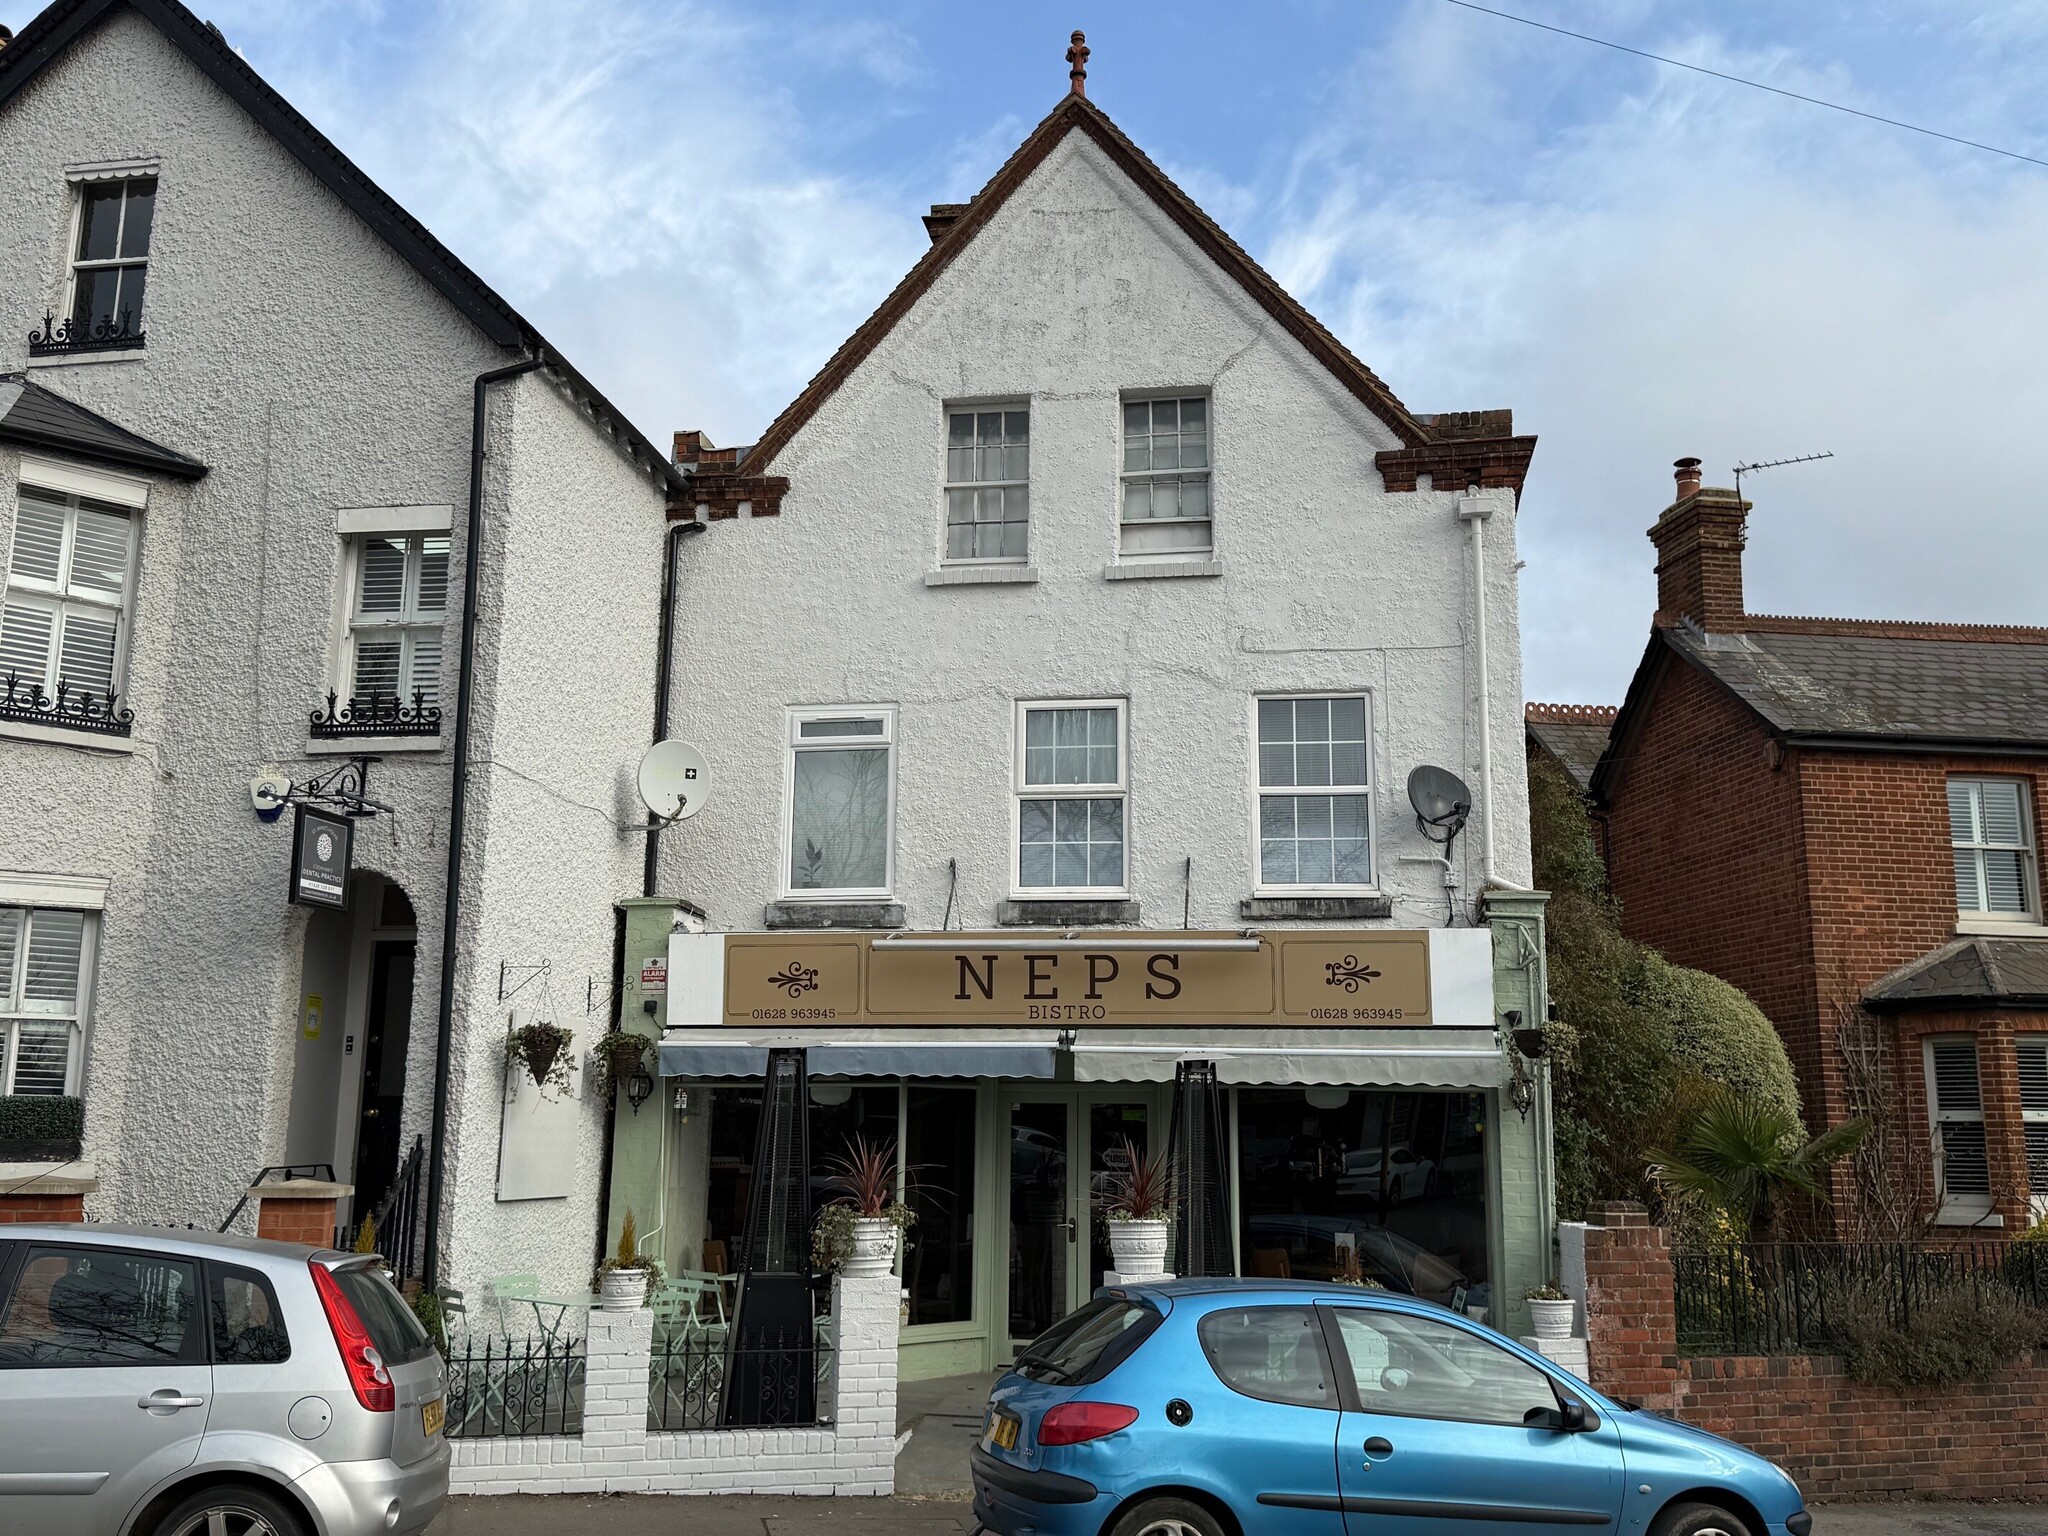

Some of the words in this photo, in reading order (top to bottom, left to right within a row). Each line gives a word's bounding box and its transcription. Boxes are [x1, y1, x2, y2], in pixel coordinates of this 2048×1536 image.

[302, 868, 320, 878] DENTAL
[321, 872, 342, 883] PRACTICE
[954, 953, 1182, 1000] NEPS
[752, 1008, 787, 1019] 01628
[790, 1008, 836, 1019] 963945
[1028, 1005, 1106, 1019] BISTRO
[1310, 1008, 1348, 1019] 01628
[1352, 1008, 1403, 1019] 963945
